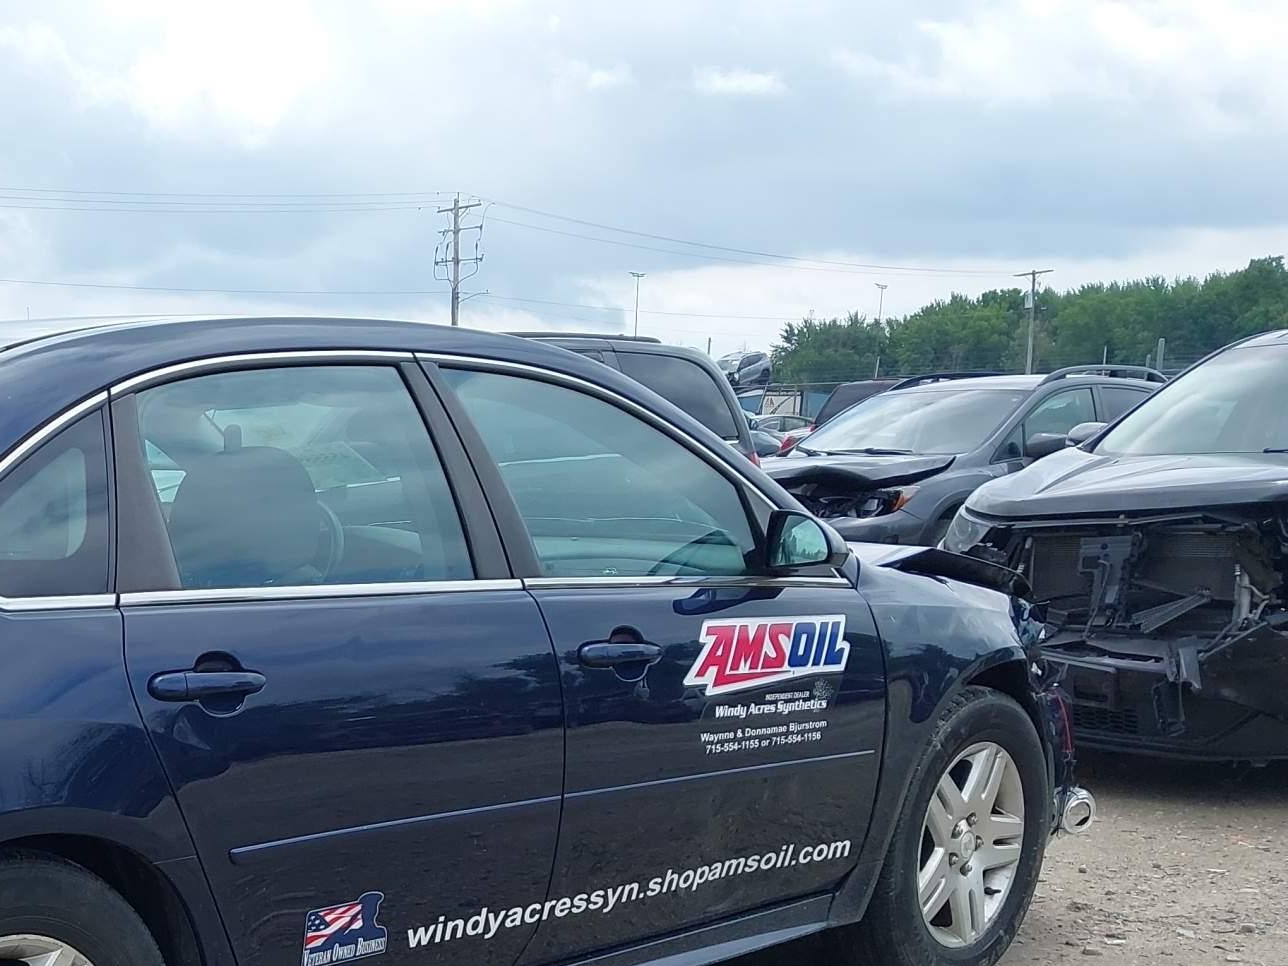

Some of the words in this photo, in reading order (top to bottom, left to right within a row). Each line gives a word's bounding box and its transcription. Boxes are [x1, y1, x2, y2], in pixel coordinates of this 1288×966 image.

[694, 621, 845, 688] AMSOIL
[765, 692, 793, 701] INDEPENDENT
[793, 690, 810, 699] DEALER
[715, 703, 747, 718] Windy
[747, 702, 776, 715] Acres
[777, 698, 828, 714] Synthetics
[736, 728, 743, 738] &
[745, 725, 788, 737] Donnamae
[789, 720, 827, 733] Bjurstrom
[706, 739, 760, 754] 715-554-1155
[761, 739, 771, 747] or
[406, 838, 852, 949] windyacressyn.shopamsoil.com
